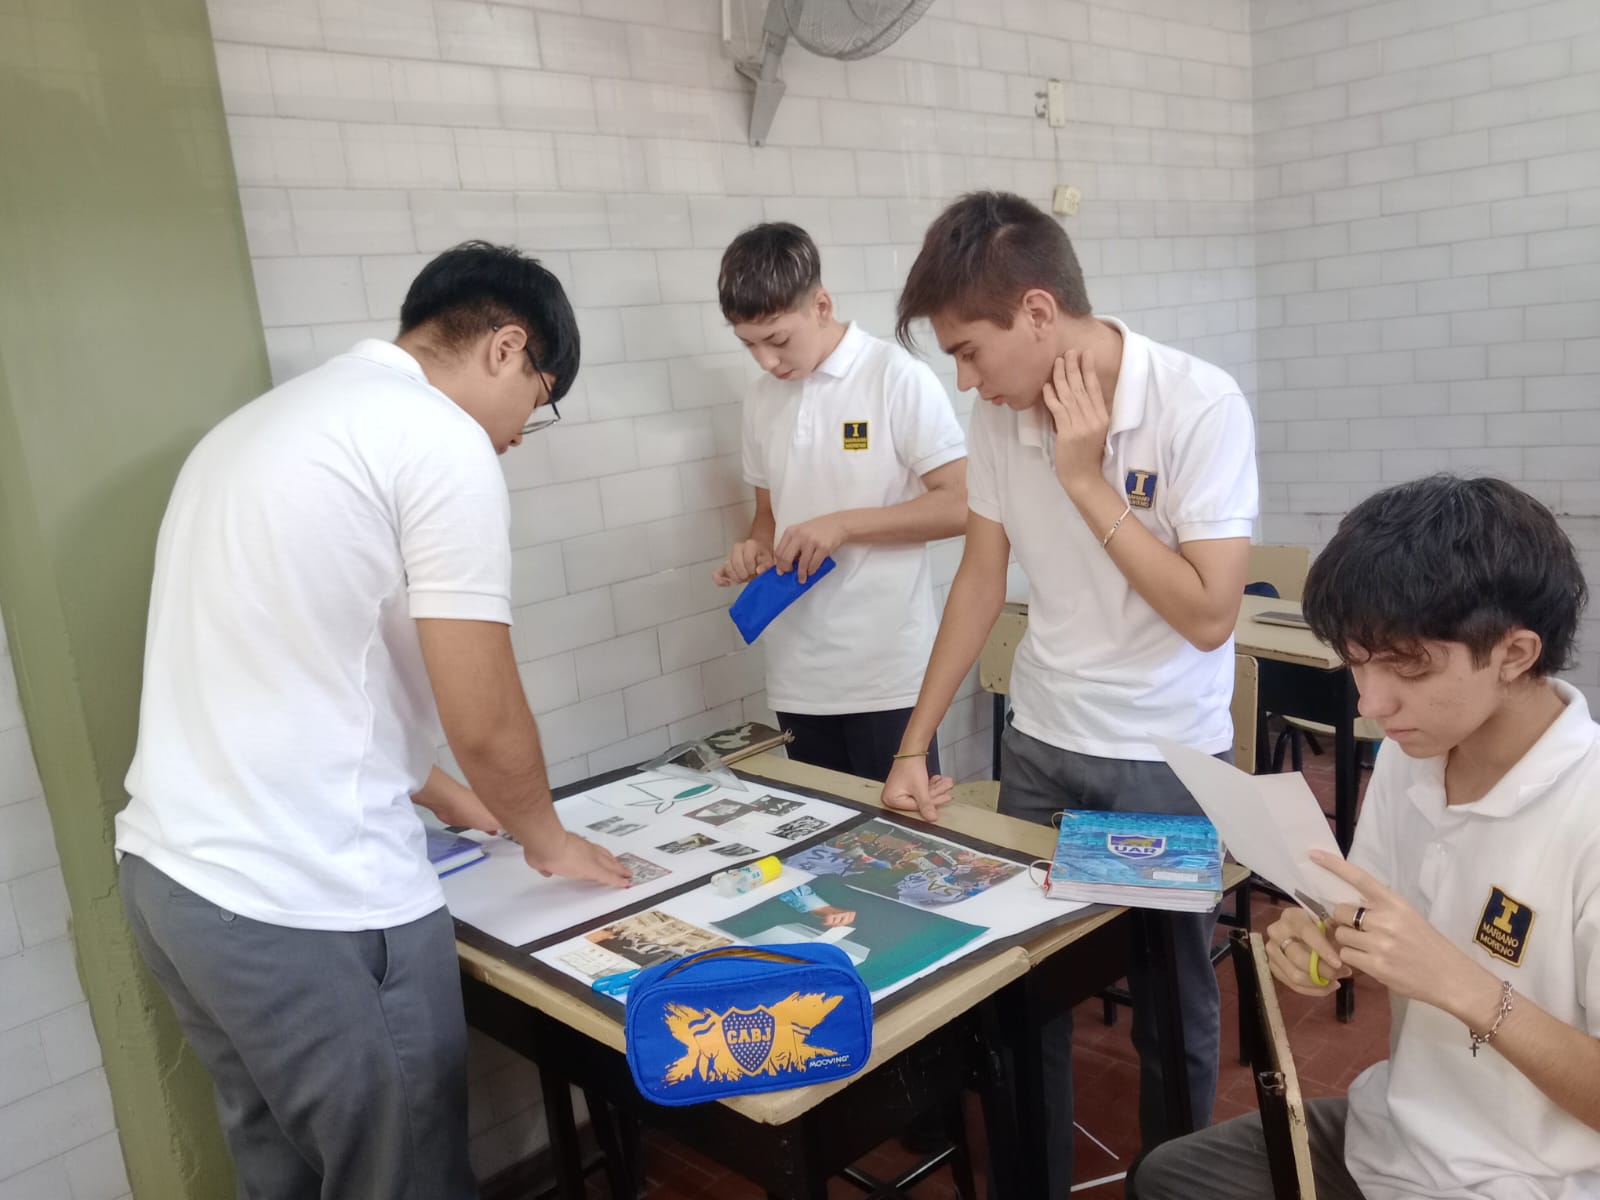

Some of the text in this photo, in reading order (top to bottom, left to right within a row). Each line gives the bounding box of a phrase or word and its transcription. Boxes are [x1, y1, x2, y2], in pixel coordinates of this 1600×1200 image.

[1493, 895, 1519, 934] I
[1480, 933, 1514, 957] MORENO
[1482, 921, 1519, 948] MARIANO
[727, 1027, 772, 1044] CABJ
[809, 1055, 847, 1068] MOOVING
